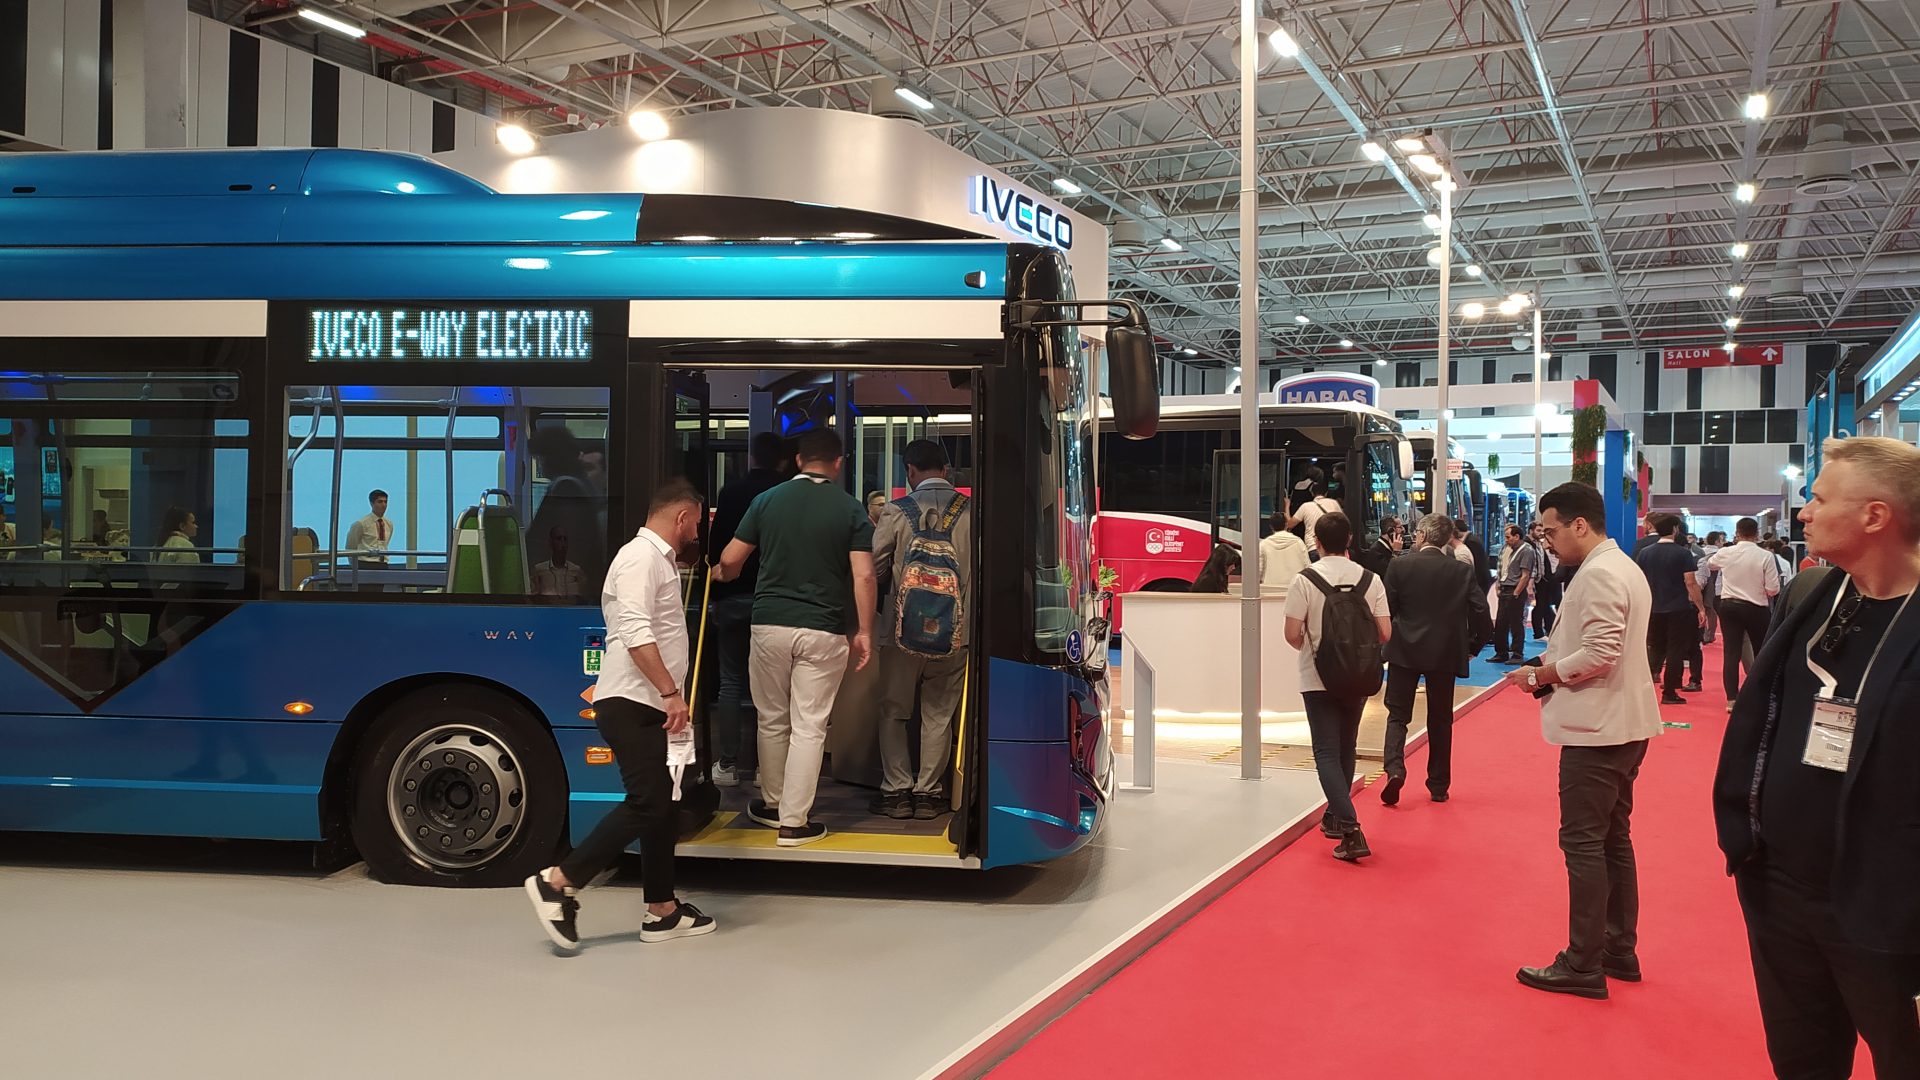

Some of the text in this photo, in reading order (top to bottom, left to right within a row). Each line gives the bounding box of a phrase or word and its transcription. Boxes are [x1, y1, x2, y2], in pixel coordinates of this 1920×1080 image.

[982, 175, 1073, 250] IVECO
[311, 311, 590, 356] IVECO E-WAY ELECTRIC
[1667, 349, 1710, 360] SALON
